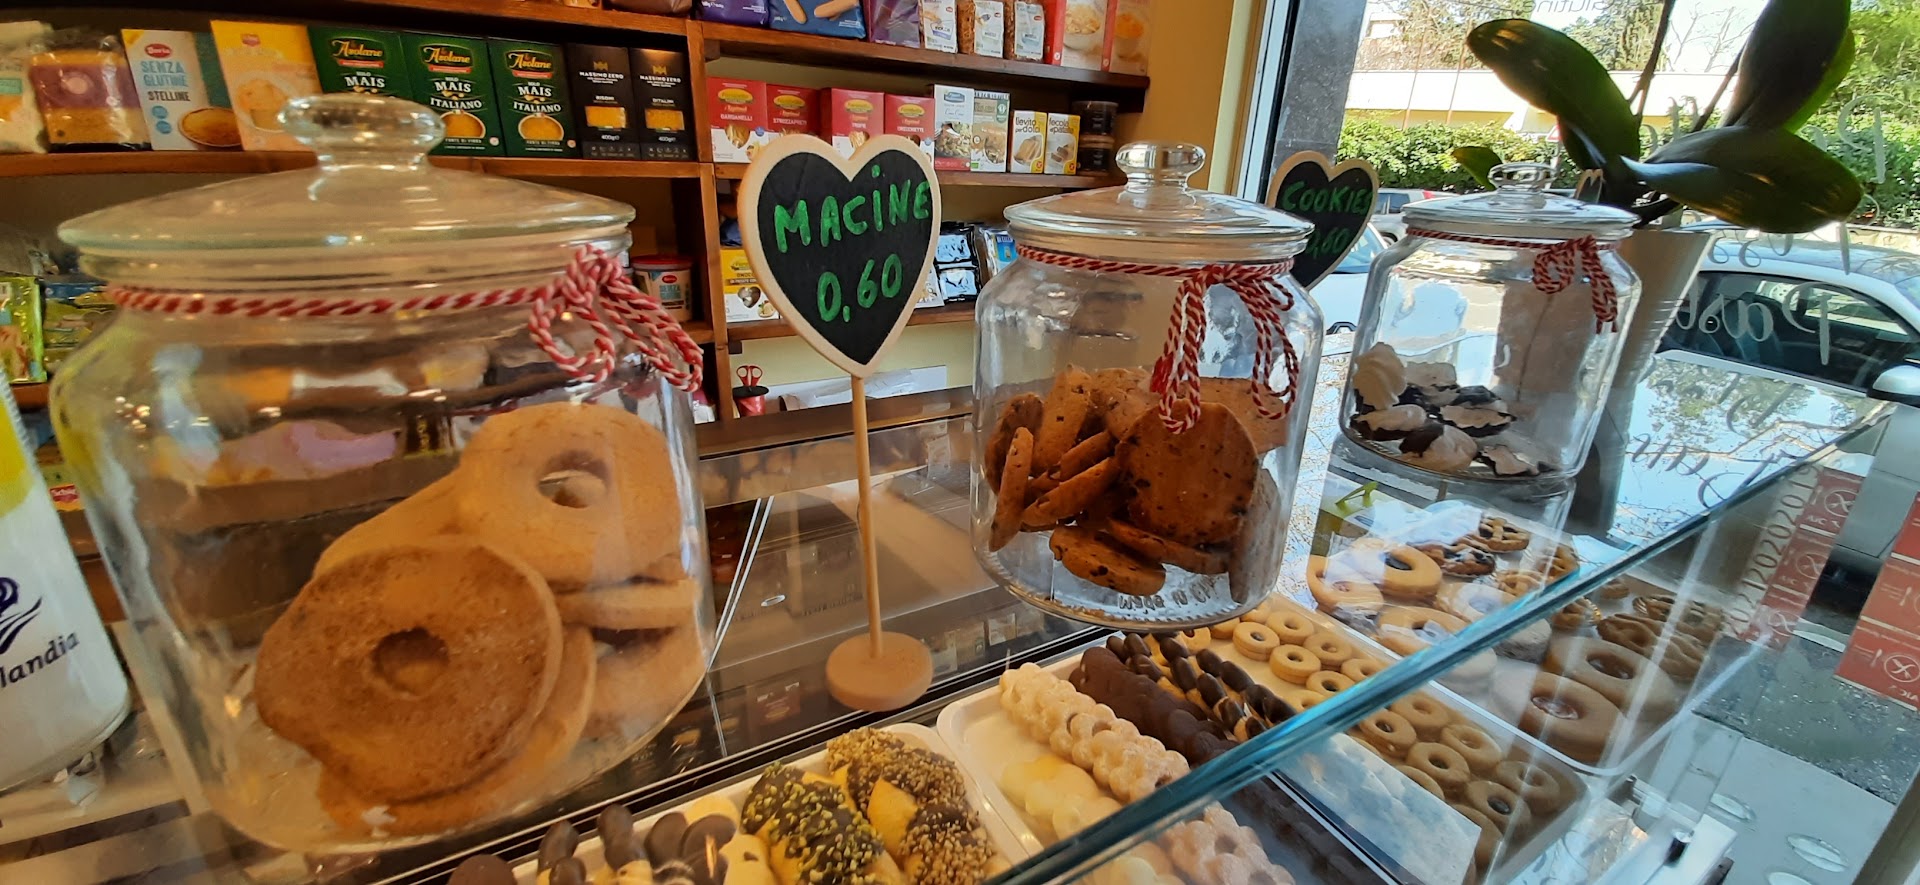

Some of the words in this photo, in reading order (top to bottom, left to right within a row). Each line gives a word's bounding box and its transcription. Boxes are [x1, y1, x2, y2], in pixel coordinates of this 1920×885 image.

[141, 60, 185, 74] SENZA
[143, 74, 189, 87] GLUTINE
[344, 76, 386, 88] MAIS
[434, 81, 472, 93] MAIS
[517, 86, 552, 97] MAIS
[147, 91, 191, 102] STELLINE
[430, 97, 483, 110] ITALIANO
[513, 101, 562, 113] ITALIANO
[773, 165, 931, 254] MACINE
[0, 633, 80, 688] landia
